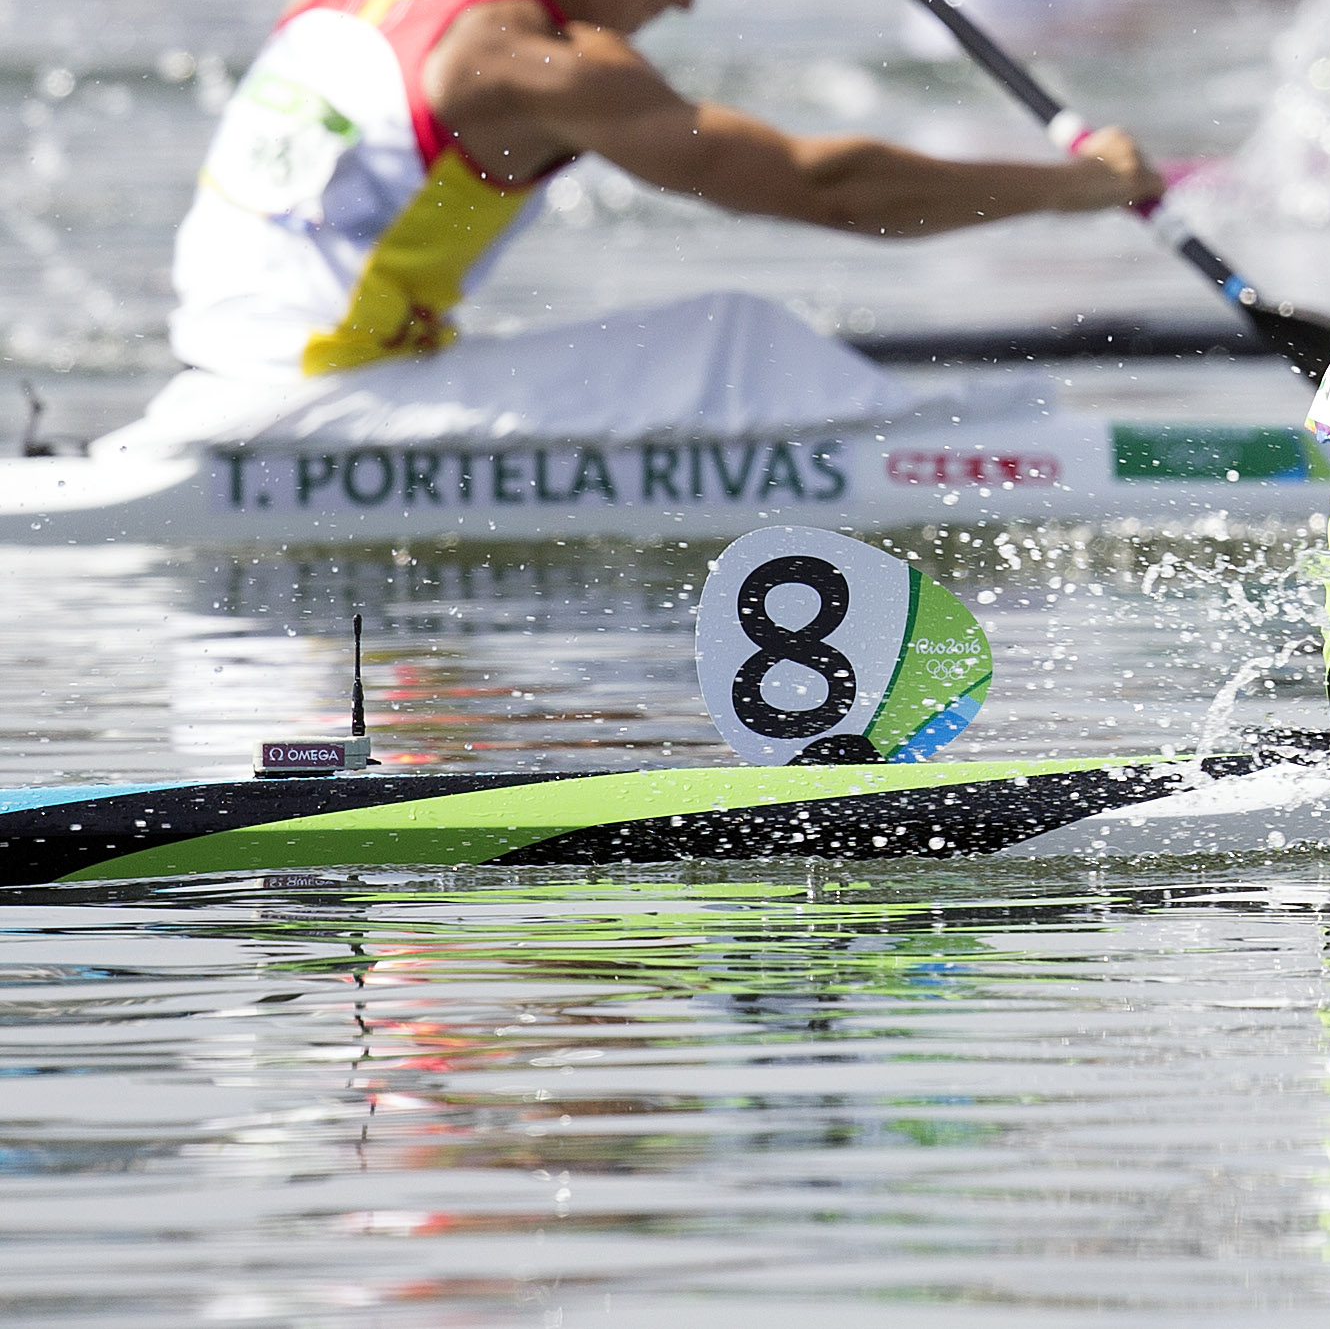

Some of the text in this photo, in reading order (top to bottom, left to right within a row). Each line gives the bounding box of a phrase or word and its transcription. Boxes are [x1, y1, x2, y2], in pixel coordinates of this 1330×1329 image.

[212, 441, 848, 508] T. PORTELA RIVAS
[732, 555, 856, 739] 8
[915, 638, 981, 655] Rio2016
[287, 749, 339, 762] OMEGA
